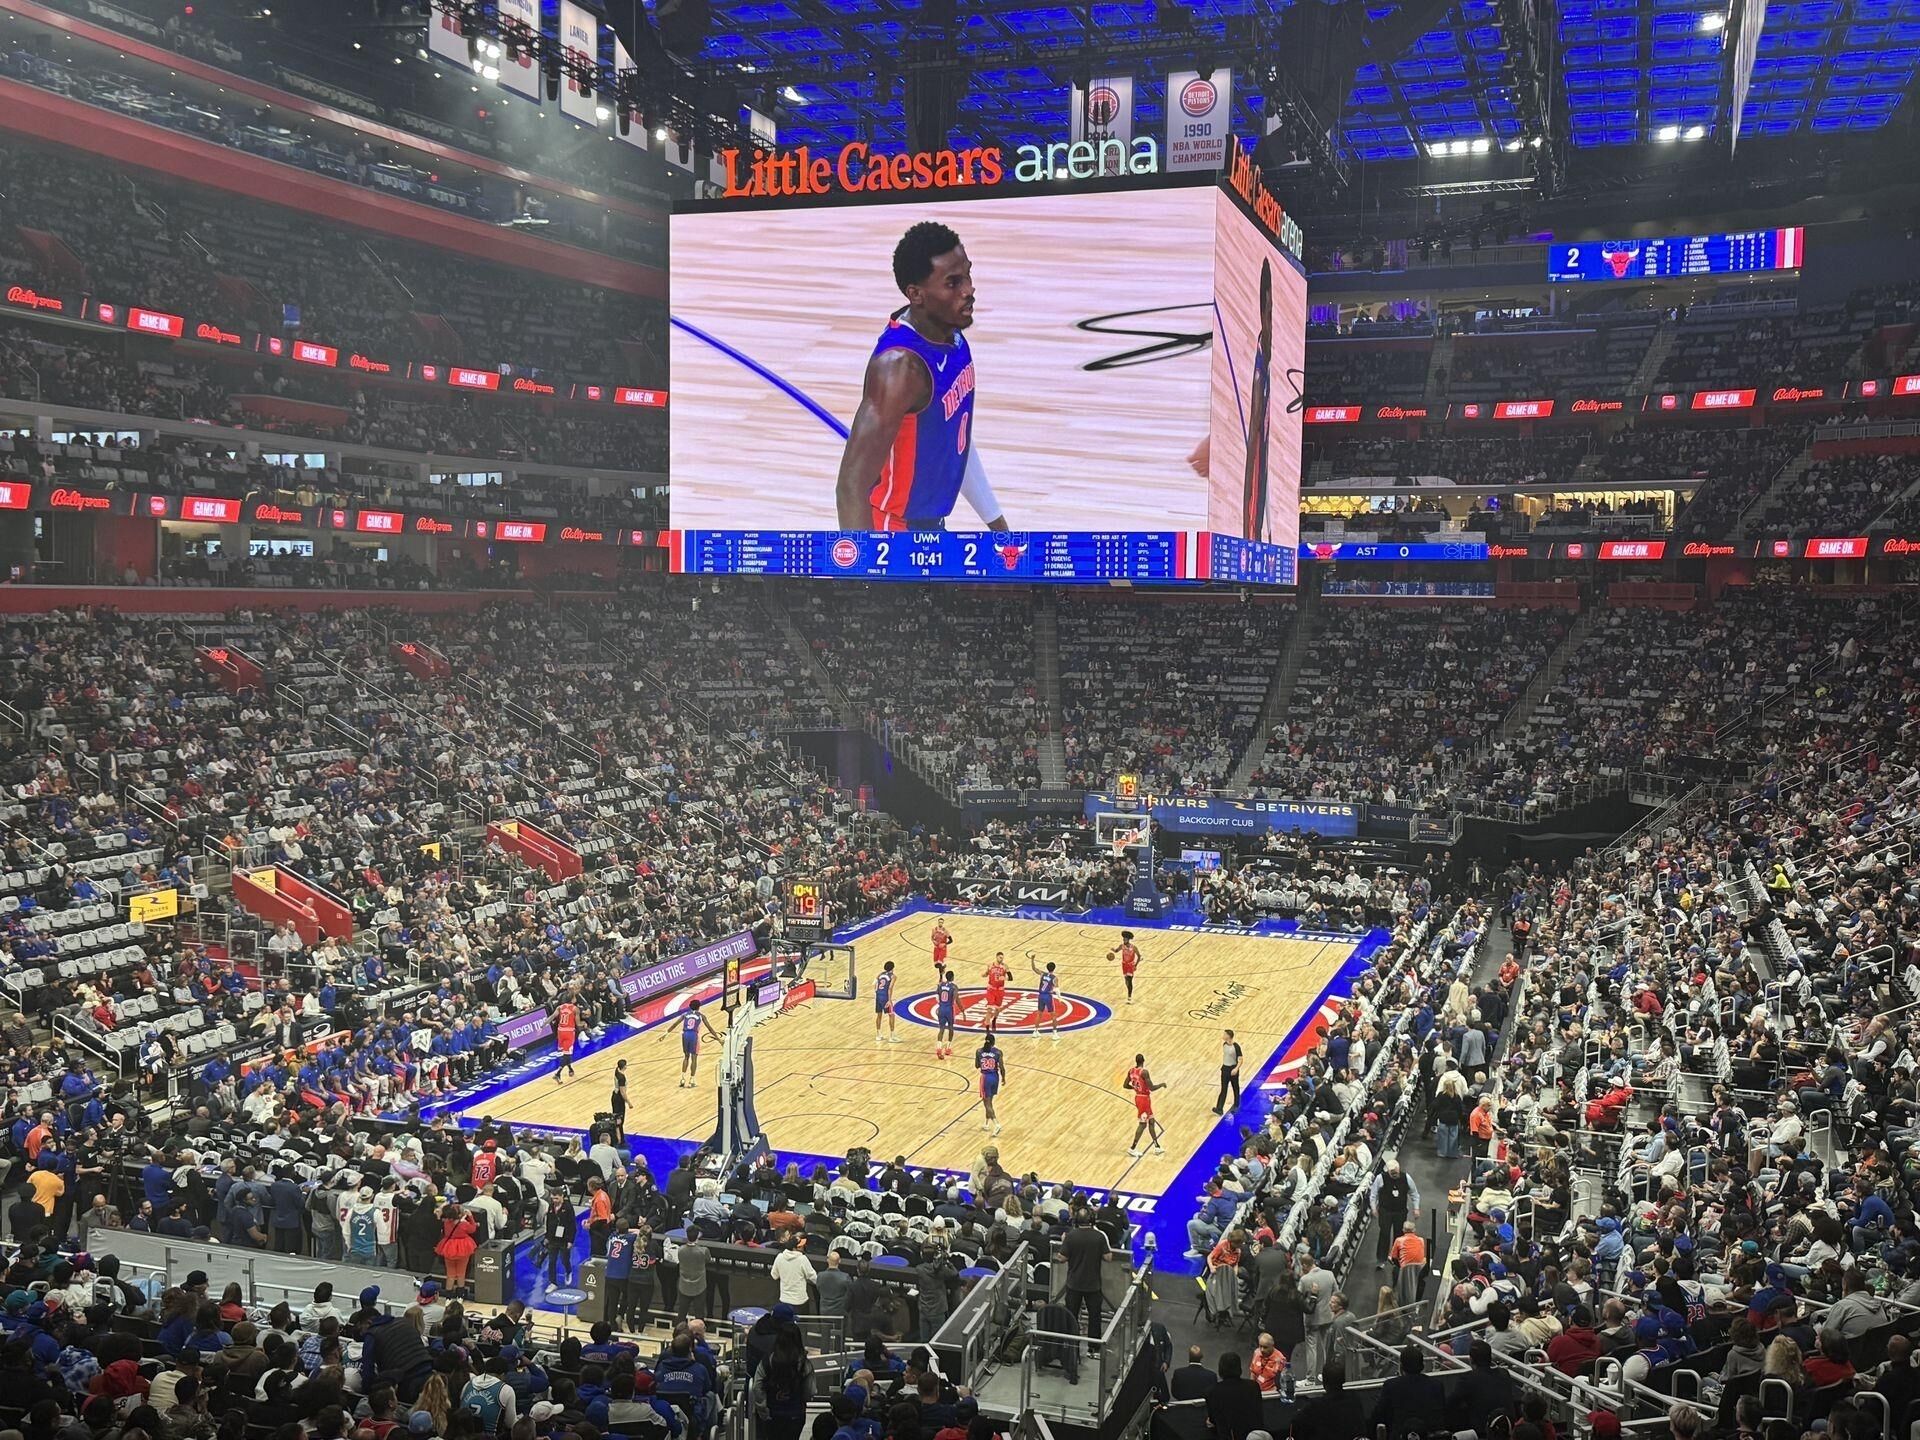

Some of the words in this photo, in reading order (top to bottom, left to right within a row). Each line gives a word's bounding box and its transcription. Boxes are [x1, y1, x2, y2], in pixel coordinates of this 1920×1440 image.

[570, 25, 588, 45] LANIER
[1184, 122, 1211, 138] 1990
[1173, 141, 1191, 152] NBA
[1193, 139, 1222, 151] WORLD
[1173, 151, 1222, 164] CHAMPIONS
[722, 146, 831, 198] Little
[837, 141, 1002, 193] Caesars
[1014, 135, 1158, 182] arena
[1230, 134, 1253, 206] Little
[1252, 164, 1281, 237] Caesars
[1280, 210, 1303, 260] arena
[1567, 248, 1579, 267] 2
[8, 286, 39, 308] Bally
[139, 313, 159, 329] GAME
[301, 345, 318, 360] GAME
[459, 371, 477, 384] GAME
[625, 390, 644, 402] GAME
[1705, 394, 1727, 406] GAME
[1773, 387, 1802, 402] Bally
[1801, 389, 1823, 398] SPORTS
[1377, 406, 1406, 420] Bally
[1405, 409, 1427, 417] SPORTS
[1506, 404, 1526, 415] GAME
[1571, 399, 1601, 413] Bally
[1600, 401, 1622, 409] SPORTS
[1315, 409, 1335, 420] GAME
[957, 411, 968, 455] 0
[51, 488, 85, 511] Bally
[193, 501, 214, 516] GAME
[256, 504, 283, 524] Bally
[366, 515, 382, 528] GAME
[416, 517, 437, 534] Bally
[504, 525, 522, 538] GAME
[913, 533, 940, 543] UWM
[876, 542, 890, 565] 2
[1356, 547, 1378, 556] AST
[1399, 546, 1409, 557] 0
[1487, 545, 1506, 558] ally
[1505, 548, 1528, 556] SPORTS
[1612, 544, 1634, 556] GAME
[1683, 542, 1712, 557] Bally
[1711, 546, 1734, 554] SPORTS
[1818, 542, 1841, 555] GAME
[1884, 538, 1911, 555] Bally
[909, 552, 942, 566] 10:41
[964, 543, 977, 566] 2
[1123, 783, 1135, 796] 19
[1139, 796, 1208, 809] TRIVERS
[1256, 802, 1353, 815] BETRIVERS
[1179, 816, 1230, 826] BACKCOURT
[1231, 817, 1254, 827] CLUB
[793, 884, 819, 897] 10:41
[799, 896, 816, 916] 19
[1168, 924, 1261, 936] DETROIT
[1268, 931, 1364, 944] PISTONS
[707, 947, 733, 964] NEXEN
[732, 938, 750, 954] TIRE
[637, 973, 667, 991] NEXEN
[665, 962, 687, 979] TIRE
[879, 978, 887, 991] 2
[940, 990, 949, 1003] 0
[687, 1018, 696, 1030] 9
[511, 1024, 534, 1039] NEXEN
[454, 1050, 564, 1098] BETRIVERS
[358, 1223, 367, 1236] 2
[611, 1241, 622, 1259] 2
